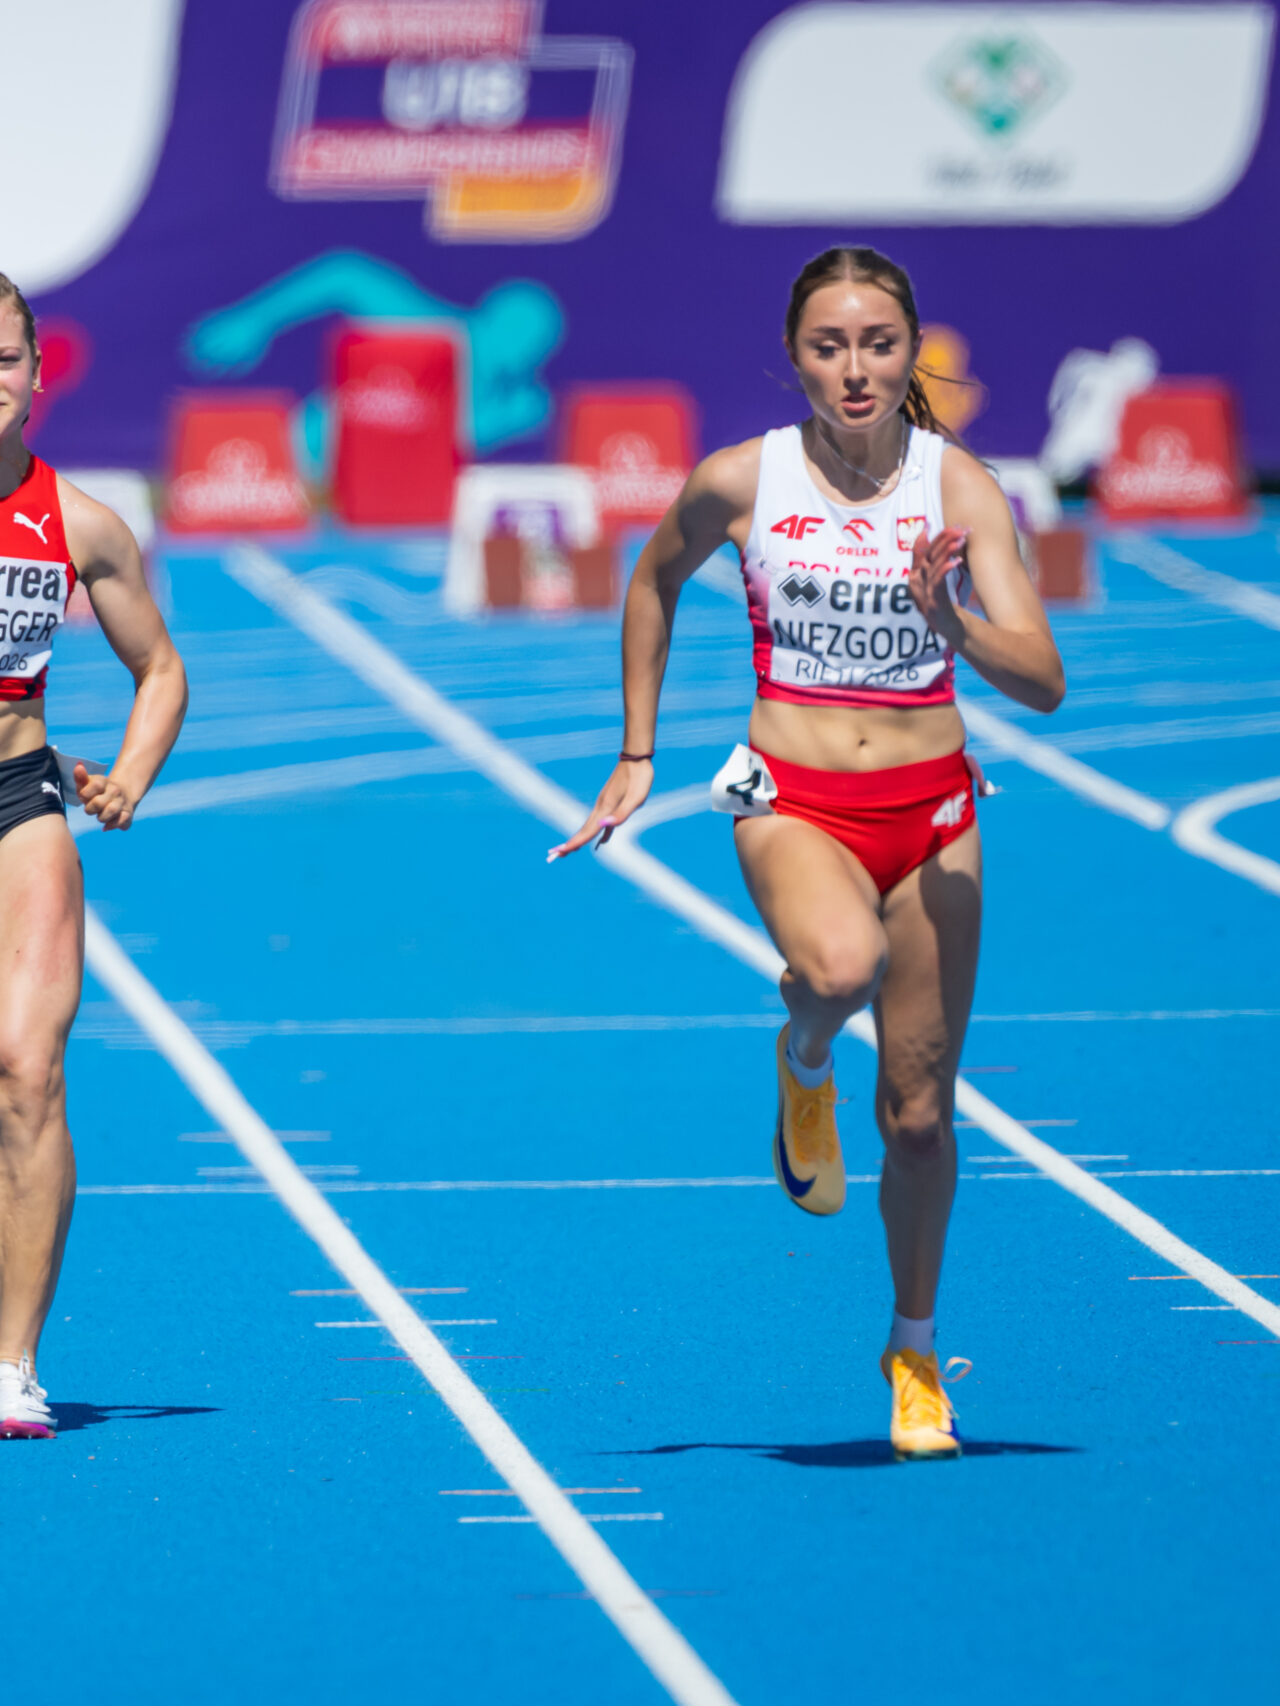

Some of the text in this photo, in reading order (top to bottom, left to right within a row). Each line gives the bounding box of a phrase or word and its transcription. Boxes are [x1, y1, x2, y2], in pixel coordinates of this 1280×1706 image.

[836, 546, 879, 556] ORLEN
[830, 579, 913, 614] erre
[773, 618, 940, 660] NIEZGODA
